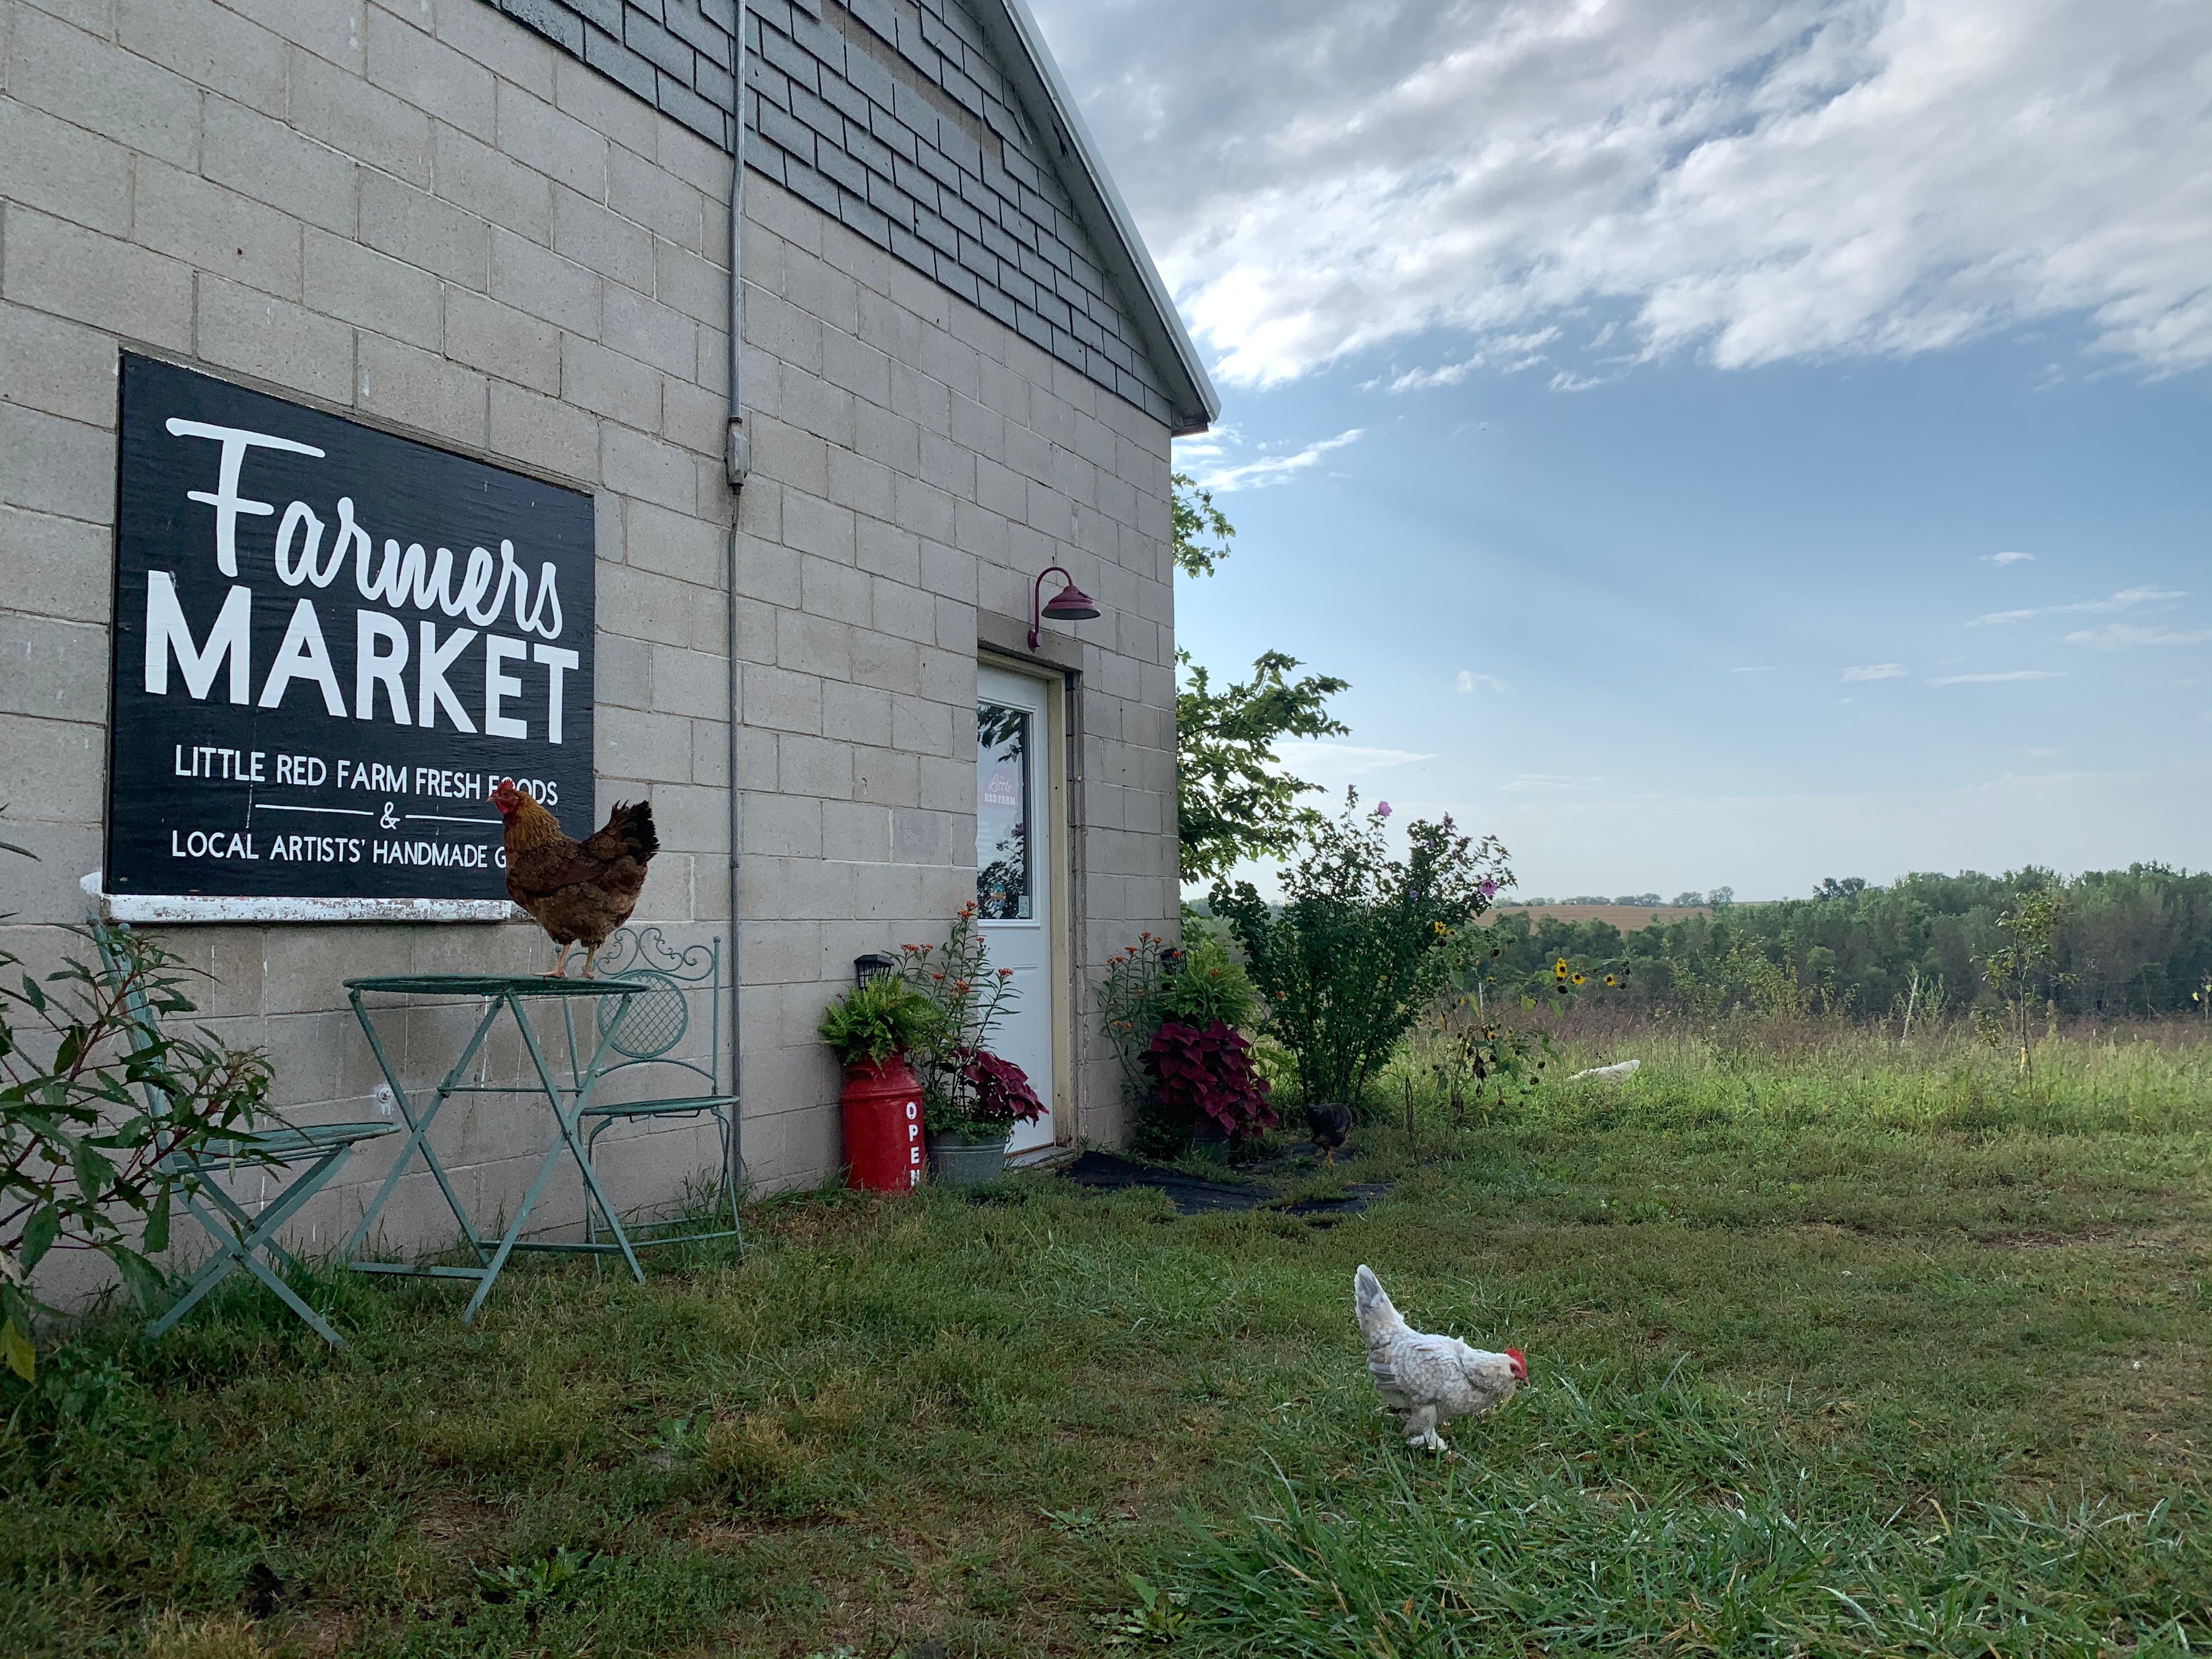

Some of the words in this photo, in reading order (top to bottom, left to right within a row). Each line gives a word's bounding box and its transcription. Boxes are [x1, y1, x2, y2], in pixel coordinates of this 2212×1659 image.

[166, 418, 562, 639] Farmers
[145, 570, 579, 744] MARKET
[176, 745, 265, 781] LITTLE
[277, 755, 326, 786] RED
[338, 760, 407, 793] FARM
[416, 768, 480, 799] FRESH
[988, 774, 1012, 793] Little
[380, 802, 400, 829] &
[984, 793, 997, 803] RED
[998, 794, 1015, 805] FARM
[173, 831, 259, 860] LOCAL
[374, 840, 487, 867] HANDMADE
[906, 1101, 920, 1186] OPEN
